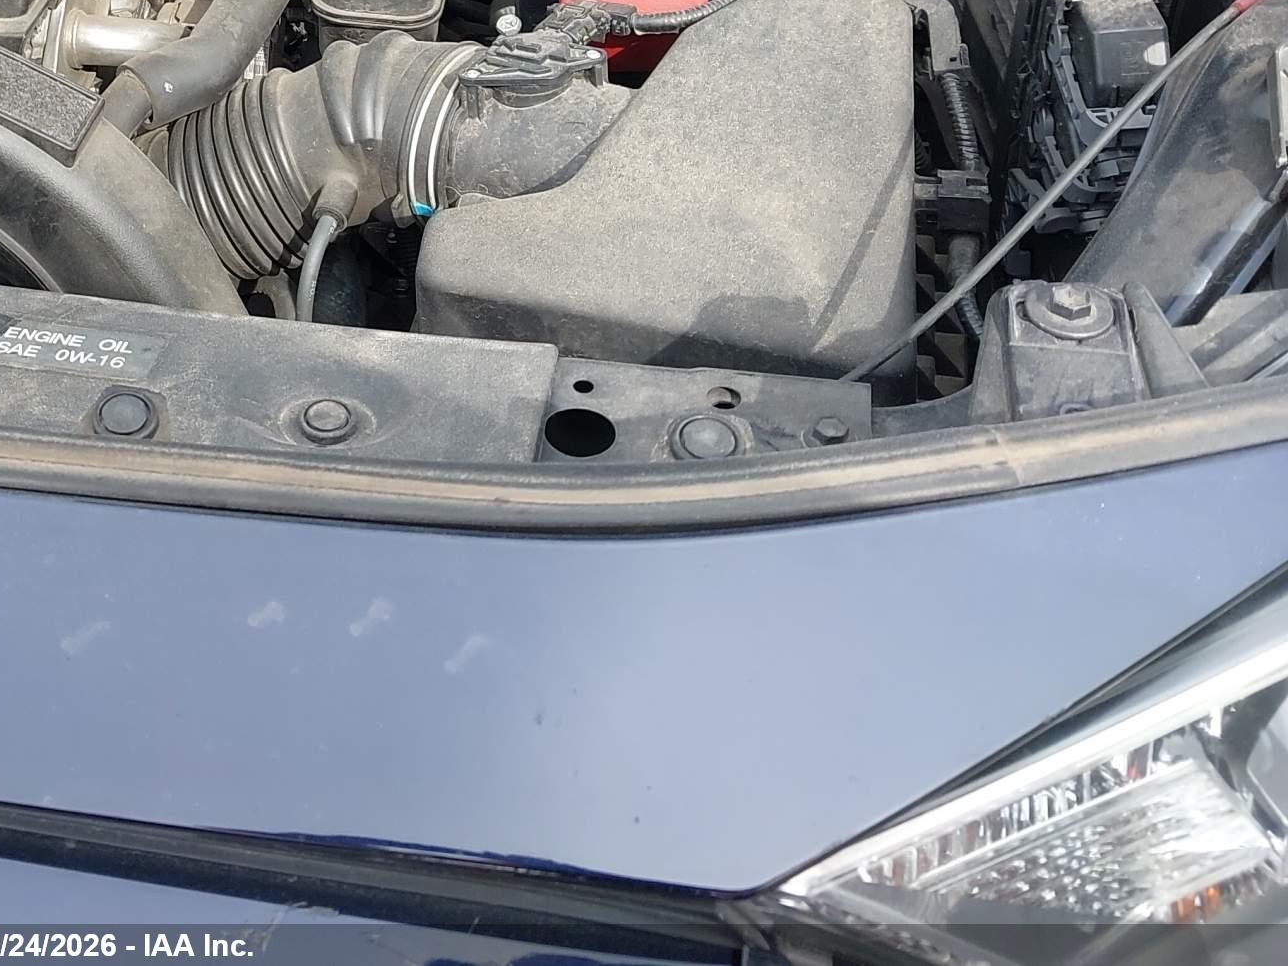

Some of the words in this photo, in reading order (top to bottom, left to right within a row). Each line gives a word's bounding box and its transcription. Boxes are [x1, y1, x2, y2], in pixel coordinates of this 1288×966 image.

[3, 326, 86, 347] ENGINE
[98, 338, 133, 354] OIL
[55, 349, 126, 369] 0W-16
